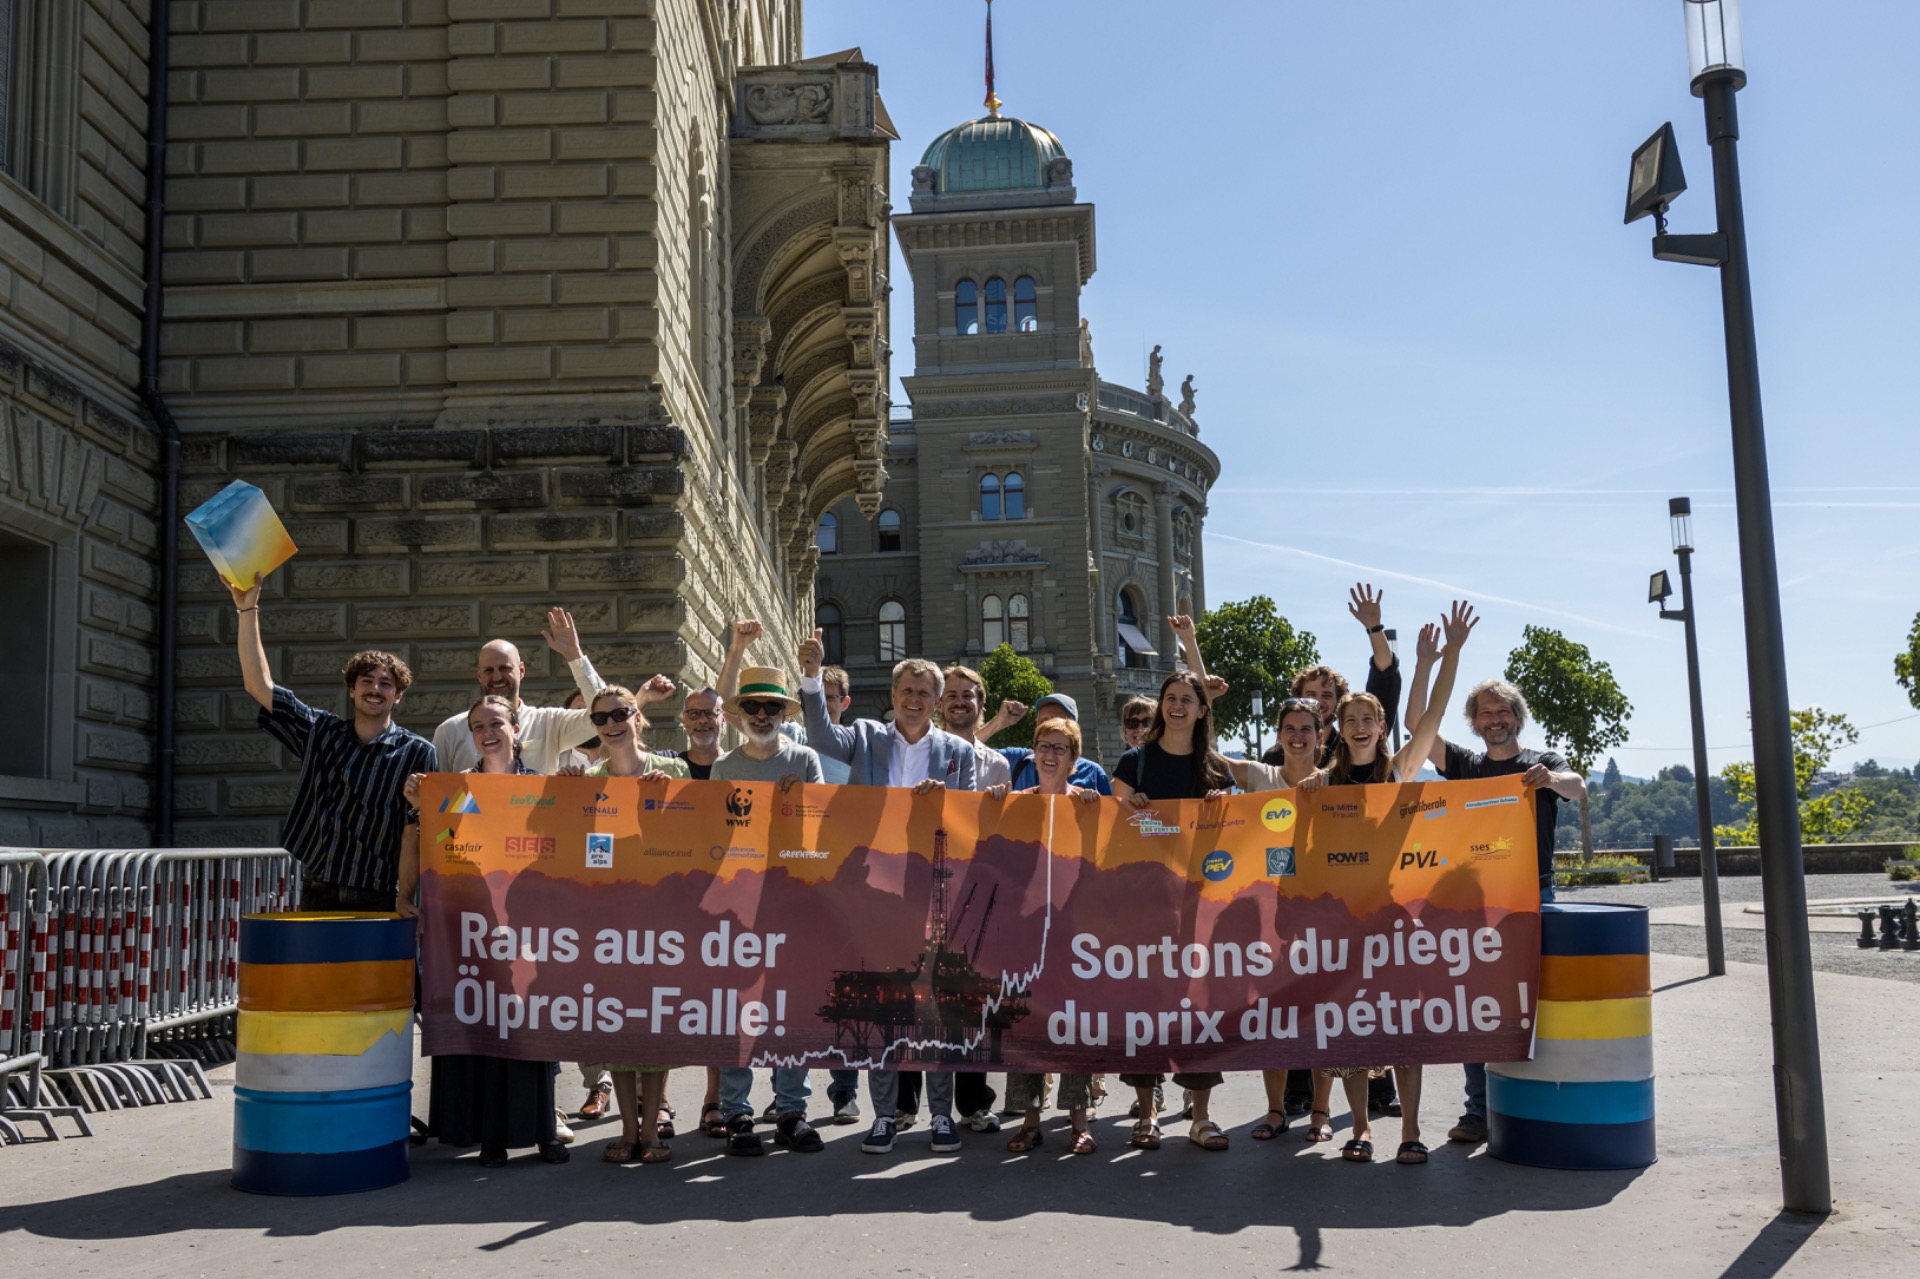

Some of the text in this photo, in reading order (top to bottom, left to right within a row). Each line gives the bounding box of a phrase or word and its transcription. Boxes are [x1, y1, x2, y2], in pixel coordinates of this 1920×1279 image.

[583, 806, 618, 815] VENALU
[1265, 808, 1292, 820] EVP
[1322, 804, 1335, 812] Die
[726, 819, 751, 827] WWF
[445, 842, 482, 854] casafair
[507, 838, 555, 852] SES
[1470, 844, 1490, 852] sses
[779, 850, 830, 859] GREENPEACE
[1328, 853, 1358, 863] POW
[1205, 860, 1232, 873] PEV
[461, 911, 787, 968] Raus aus der
[1071, 917, 1503, 980] Sortons du piège
[454, 965, 787, 1039] Ölpreis-Falle!
[1048, 981, 1531, 1057] du prix du pétrole !
